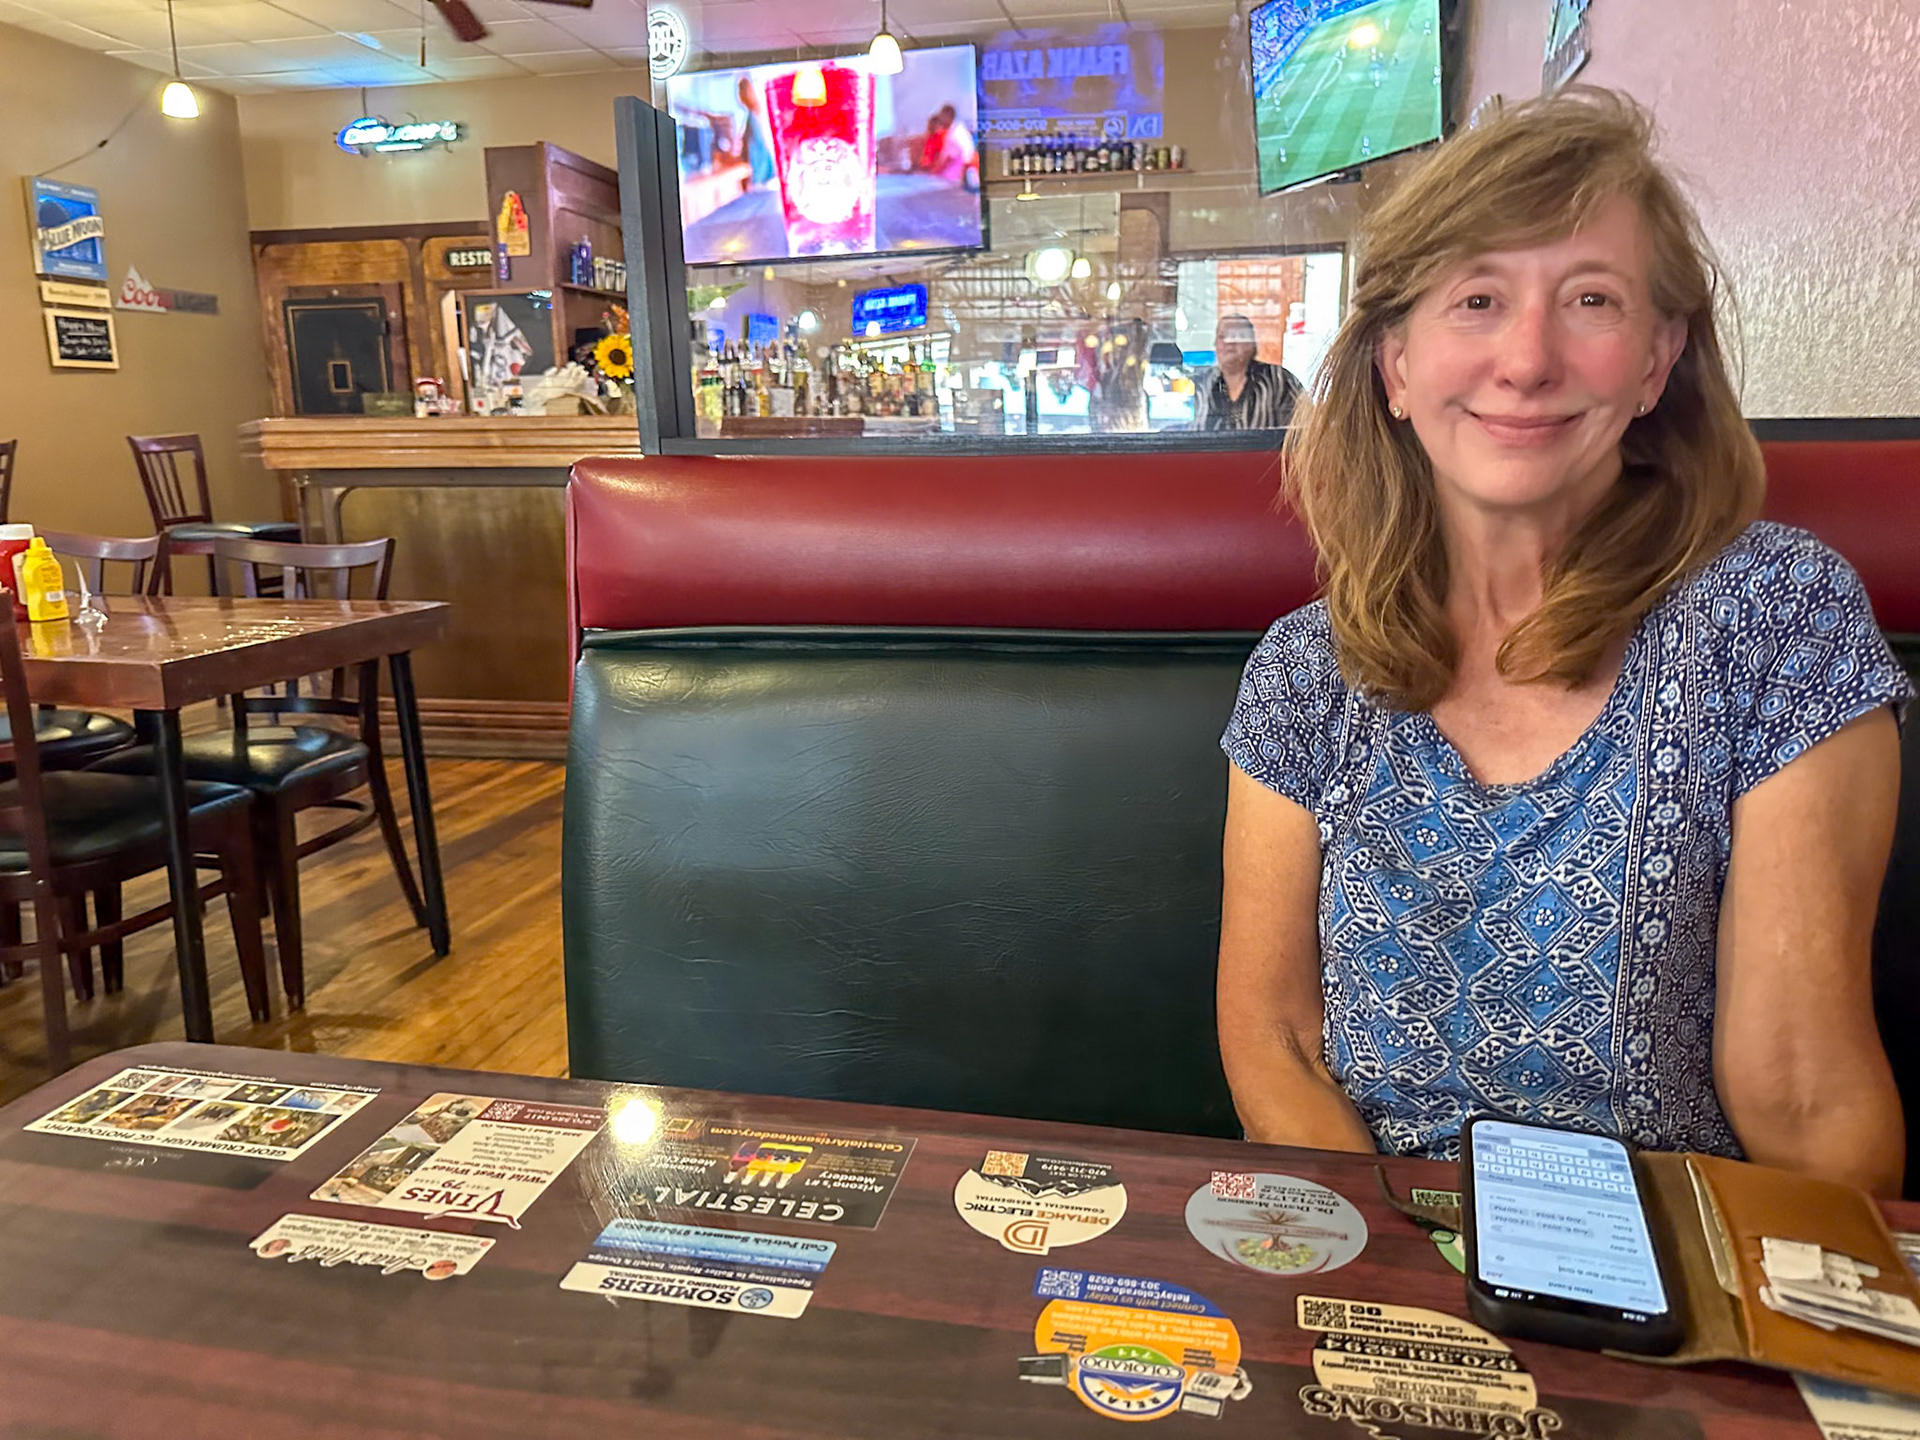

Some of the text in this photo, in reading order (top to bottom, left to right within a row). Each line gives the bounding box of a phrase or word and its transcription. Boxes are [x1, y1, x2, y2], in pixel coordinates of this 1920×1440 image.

[73, 219, 102, 241] MOON
[39, 1122, 133, 1140] PHOTOGRAPHY
[135, 1133, 154, 1142] GC
[162, 1137, 246, 1153] CRUMBAUGH
[710, 1126, 903, 1153] CelestialArtisanMeadery.com
[247, 1146, 287, 1157] GEOFF
[680, 1156, 717, 1167] Mead
[473, 1170, 506, 1179] West
[819, 1170, 876, 1185] Meadery
[804, 1178, 884, 1193] Arizona's #1
[653, 1186, 845, 1221] CELESTIAL
[975, 1195, 1032, 1206] RESIDENTIAL
[1044, 1202, 1104, 1213] COMMERCIAL
[964, 1202, 1110, 1226] DEFIANCE ELECTRIC
[694, 1231, 828, 1252] Call Patrick Sommers
[588, 1253, 622, 1265] Design
[632, 1259, 665, 1269] Install
[608, 1270, 676, 1284] MECHANICAL
[704, 1268, 734, 1278] Boiler
[748, 1272, 812, 1288] Specializing
[687, 1279, 740, 1292] PLUMBING
[1088, 1274, 1161, 1290] 303-869-0528
[599, 1277, 735, 1305] SOMMERS
[1087, 1283, 1190, 1303] RelayColorado.com
[1083, 1290, 1206, 1313] Connect with us today!
[1349, 1315, 1394, 1326] Estimate
[1396, 1320, 1419, 1328] FREE
[1349, 1322, 1487, 1345] Servicing the Grand Valley
[1445, 1325, 1462, 1334] Call
[1144, 1332, 1202, 1347] Connected
[1118, 1348, 1153, 1360] 711
[1322, 1339, 1518, 1372] 970.361.8294
[1343, 1356, 1370, 1365] MORE
[1083, 1358, 1182, 1378] COLORADO
[1321, 1360, 1359, 1372] Carpentry
[1360, 1366, 1388, 1375] Interior
[1384, 1362, 1407, 1370] TRIM
[1409, 1364, 1462, 1376] CABINETS,
[1464, 1370, 1501, 1381] DOORS,
[1093, 1390, 1161, 1410] RELAY
[1299, 1385, 1561, 1440] JOHNSON'S
